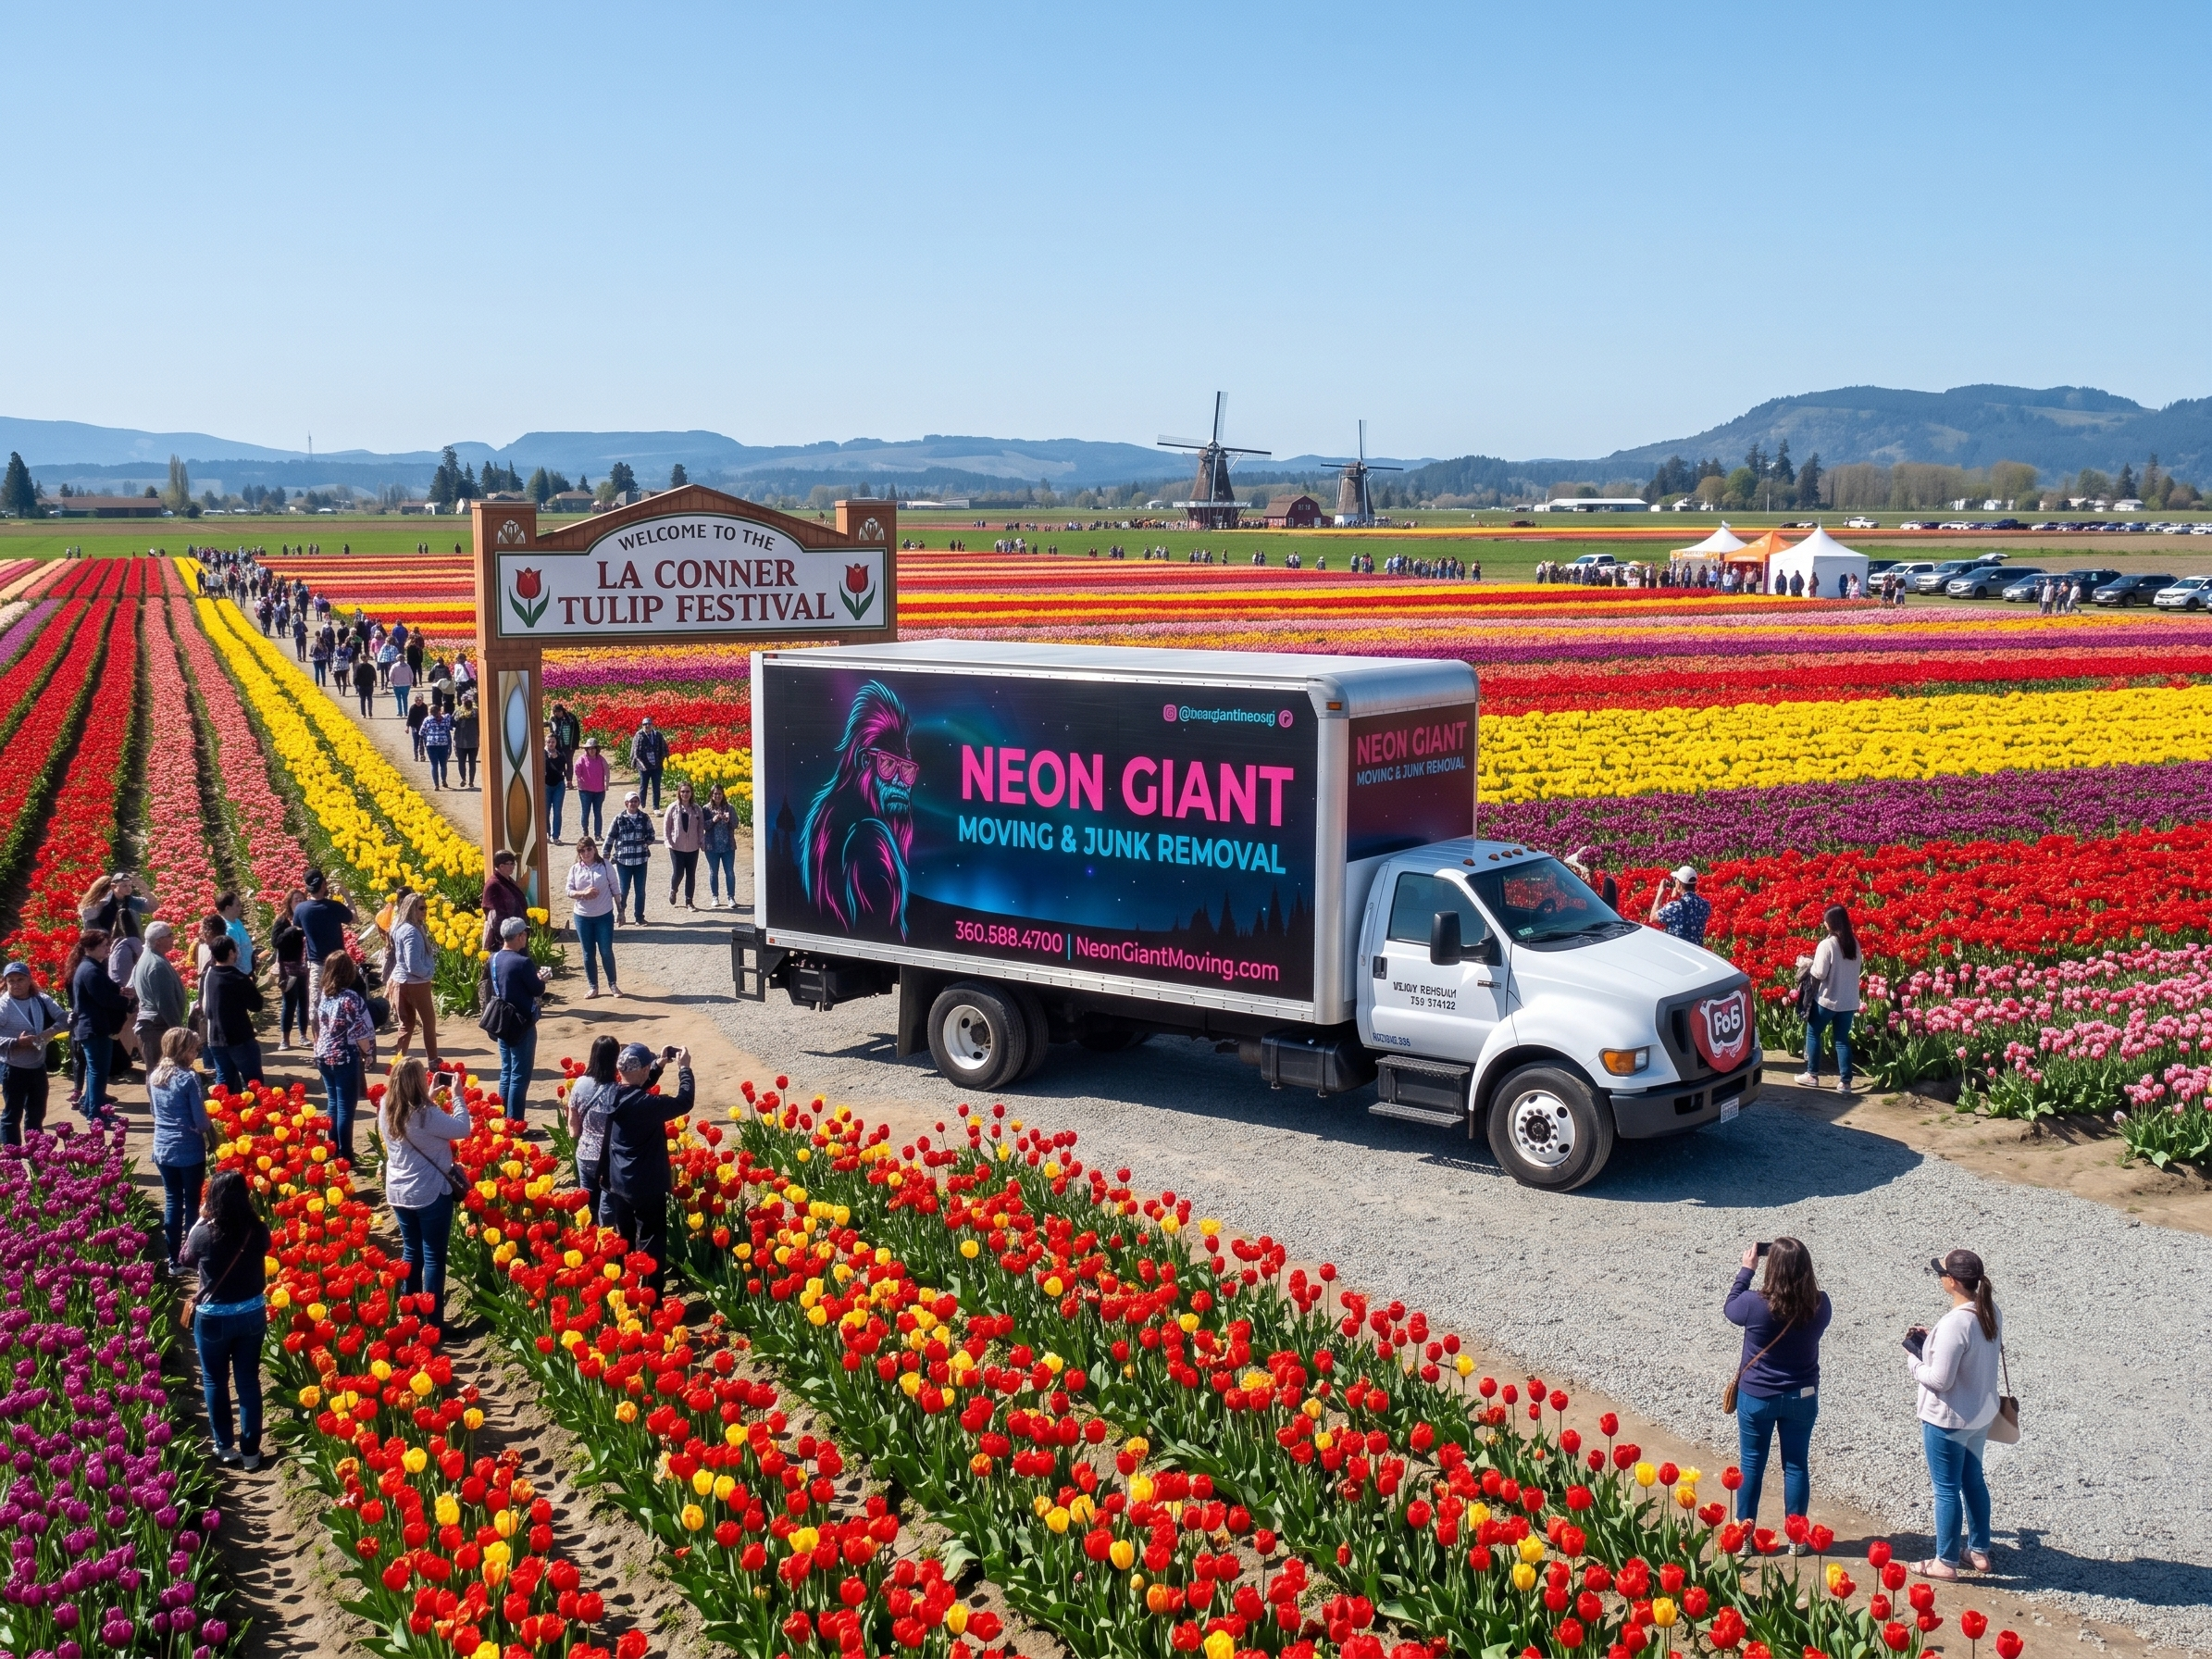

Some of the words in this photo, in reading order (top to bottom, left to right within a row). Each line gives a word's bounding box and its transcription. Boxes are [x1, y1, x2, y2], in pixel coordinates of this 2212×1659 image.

[617, 523, 707, 552] WELCOME
[713, 524, 737, 541] TO
[742, 529, 776, 552] THE
[597, 560, 643, 590] LA
[654, 559, 799, 589] CONNER
[557, 595, 664, 625] TULIP
[676, 592, 835, 623] FESTIVAL
[1357, 729, 1408, 766] NEON
[1412, 720, 1468, 756] GIANT
[1395, 766, 1401, 780] &
[1402, 762, 1425, 778] JUNK
[1426, 755, 1466, 775] REMOVAL
[962, 744, 1103, 812] NEON
[1122, 755, 1294, 827] GIANT
[959, 815, 1053, 851] MOVING
[1061, 824, 1076, 854] &
[1083, 827, 1151, 861] JUNK
[1158, 833, 1286, 875] REMOVAL
[955, 920, 1063, 954] 360.588.4700
[1076, 936, 1279, 981] NeonGiantMoving.com
[1427, 998, 1456, 1010] 374122
